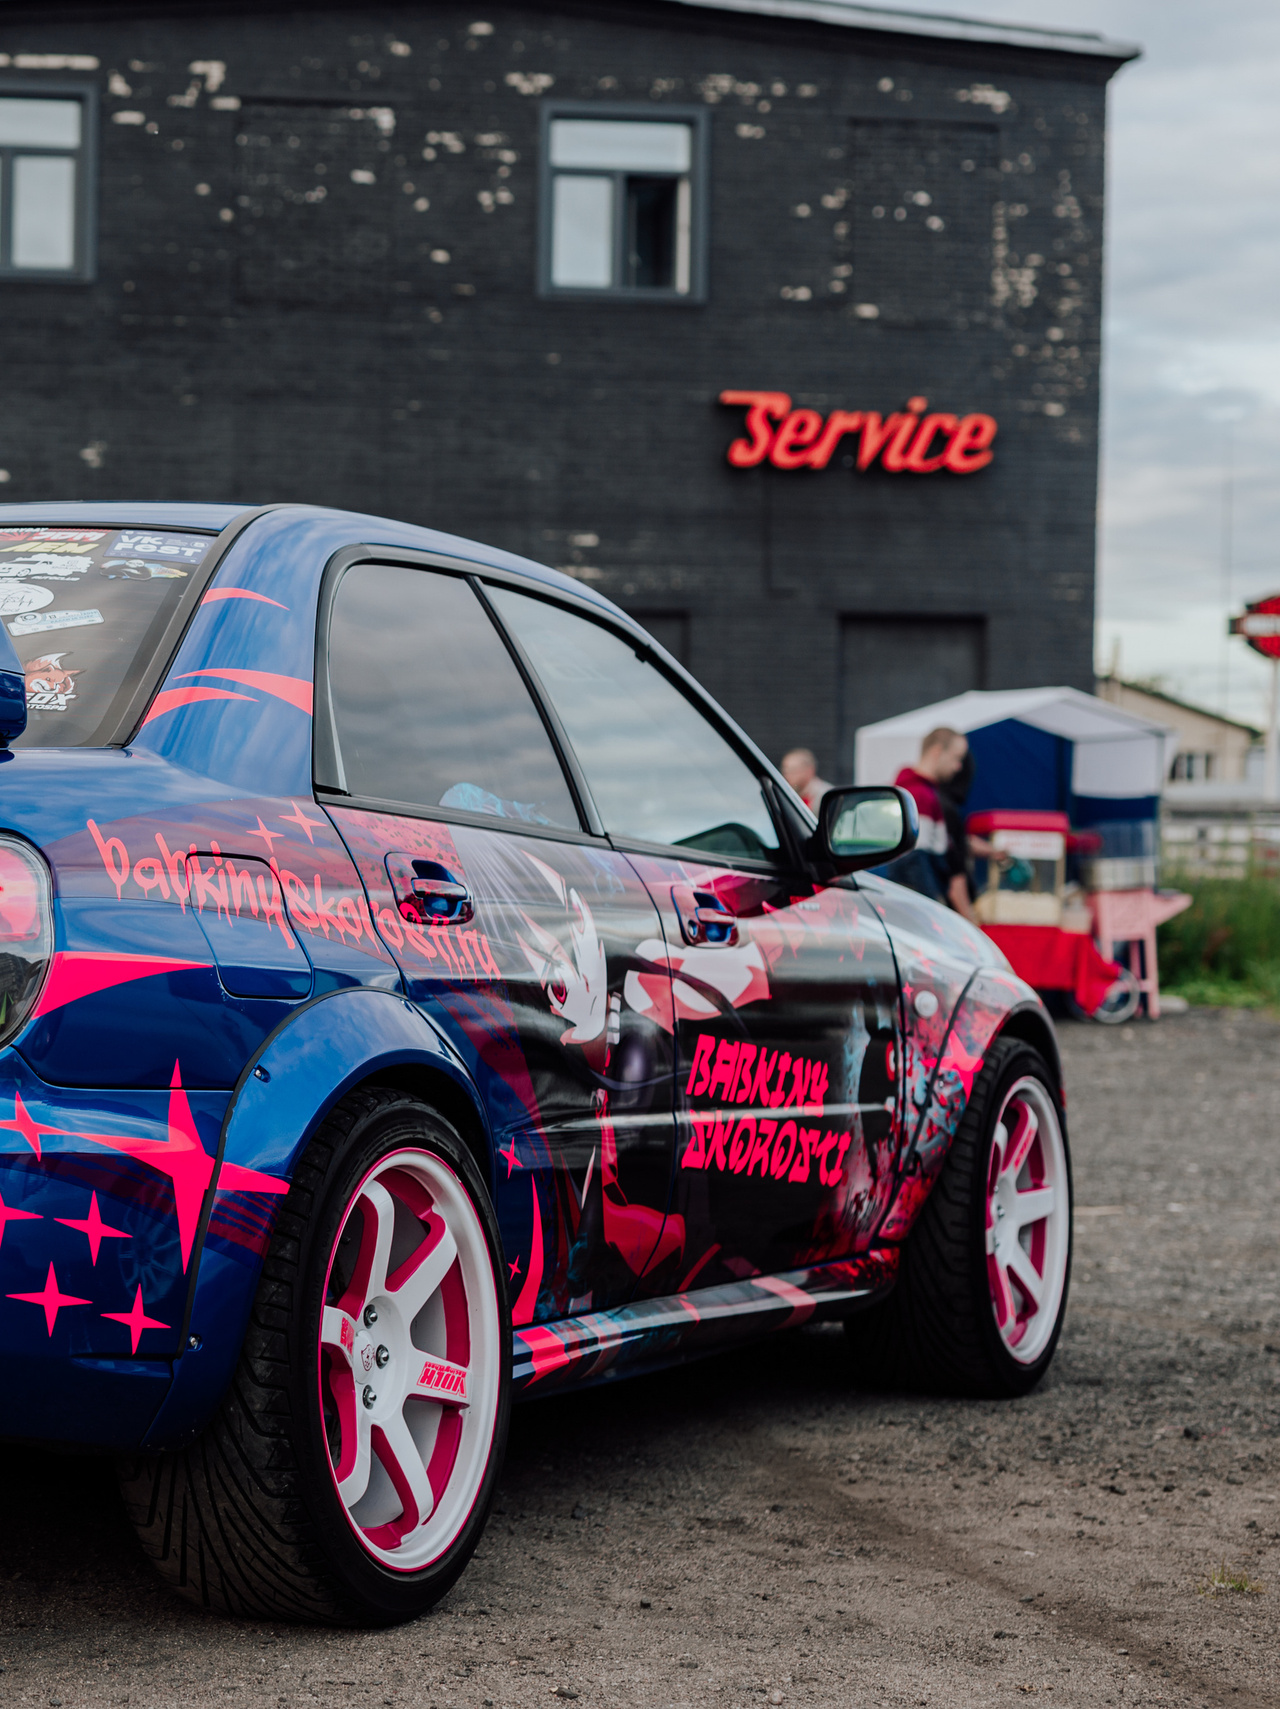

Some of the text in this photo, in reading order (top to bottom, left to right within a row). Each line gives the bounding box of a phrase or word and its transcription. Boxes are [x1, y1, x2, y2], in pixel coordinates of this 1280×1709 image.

[719, 389, 998, 474] Service
[120, 535, 164, 545] VK
[686, 1034, 830, 1118] BABKINY
[419, 1367, 466, 1397] VOLK
